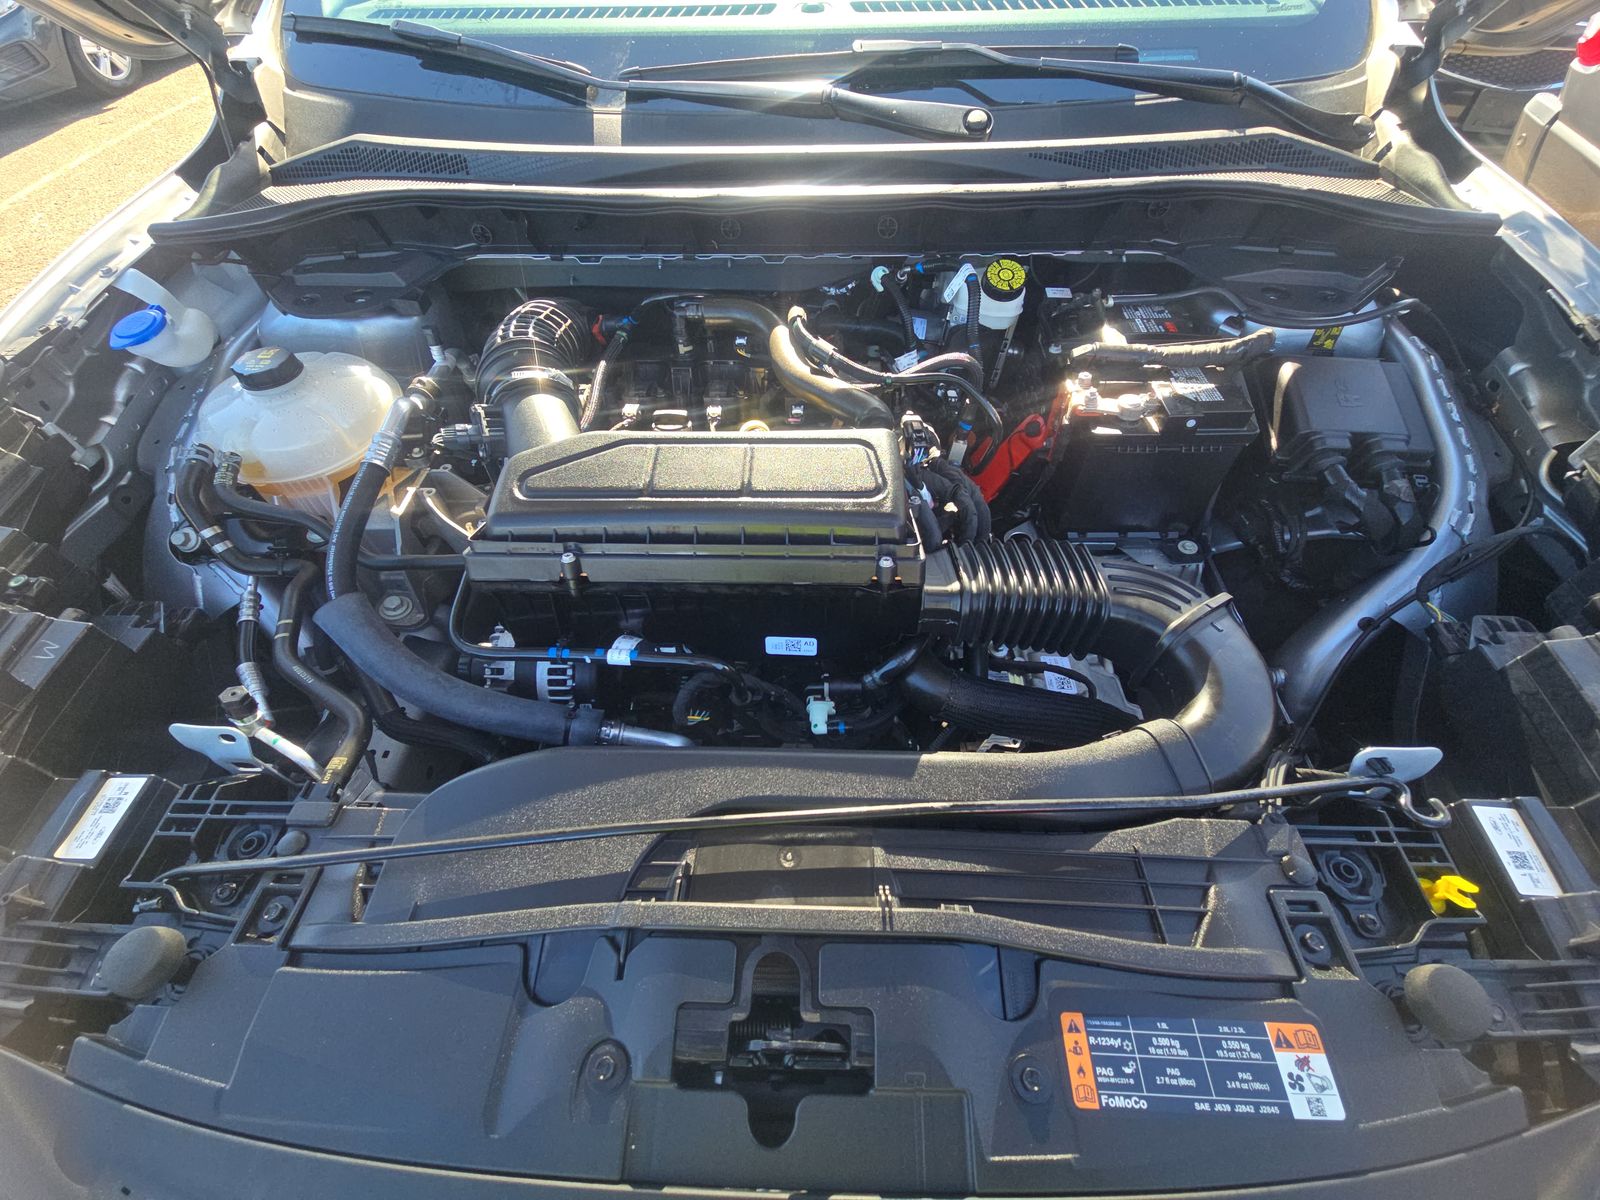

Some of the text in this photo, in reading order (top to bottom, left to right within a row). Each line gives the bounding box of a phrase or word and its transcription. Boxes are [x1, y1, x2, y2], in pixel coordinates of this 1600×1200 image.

[1088, 1036, 1122, 1048] R-1234yf
[1170, 1038, 1180, 1048] kg
[1240, 1041, 1250, 1052] kg
[1096, 1067, 1114, 1076] PAG
[1166, 1068, 1181, 1076] PAG
[1238, 1072, 1252, 1080] PAG
[1101, 1095, 1148, 1109] FoMoCo
[1194, 1102, 1211, 1111] SAE
